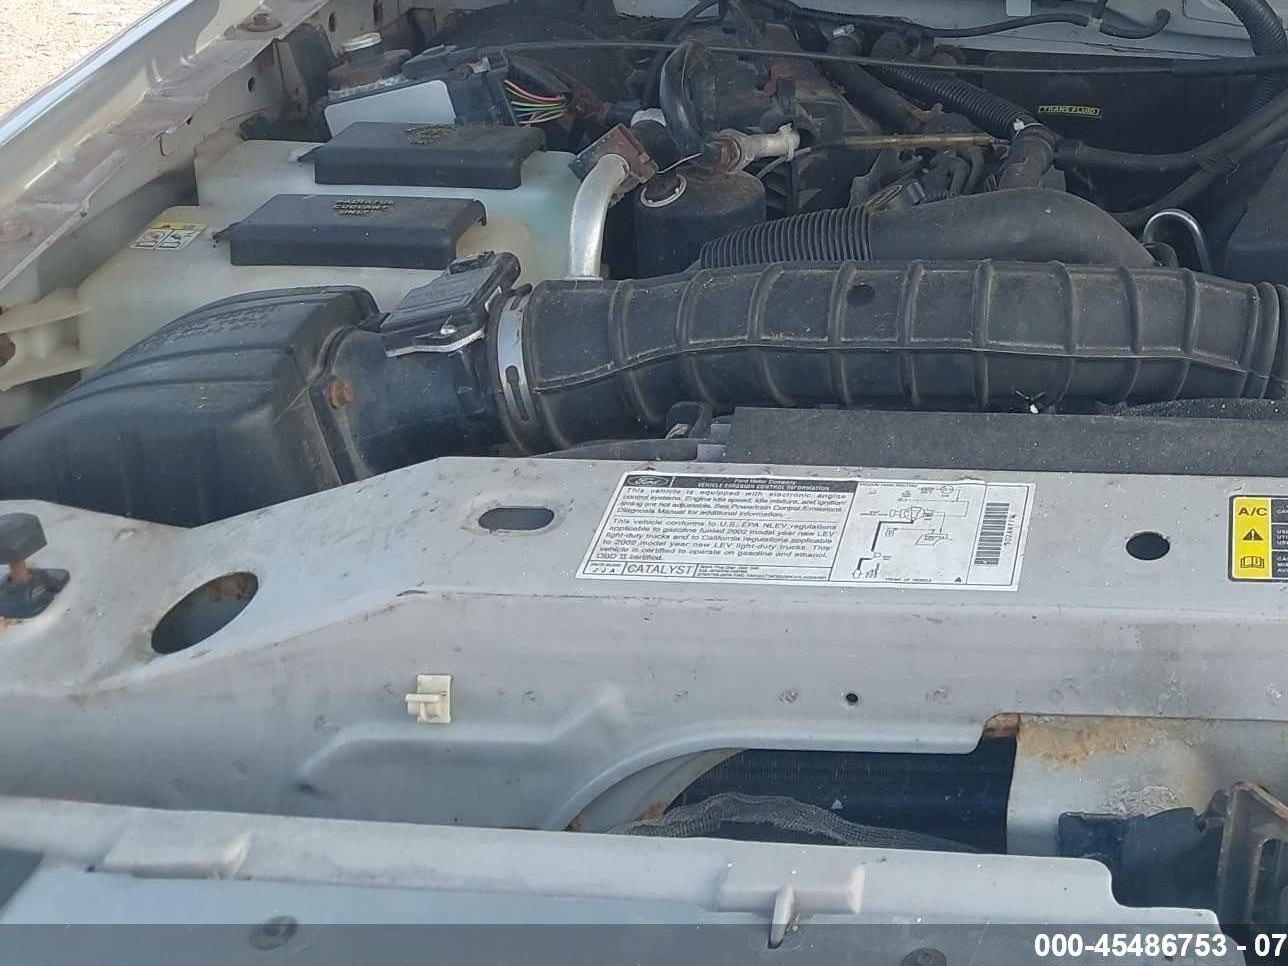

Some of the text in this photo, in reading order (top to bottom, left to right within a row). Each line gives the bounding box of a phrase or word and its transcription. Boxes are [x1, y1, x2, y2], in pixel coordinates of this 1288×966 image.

[635, 476, 660, 485] Ford
[1238, 507, 1268, 516] A/C
[627, 564, 694, 574] CATALYST
